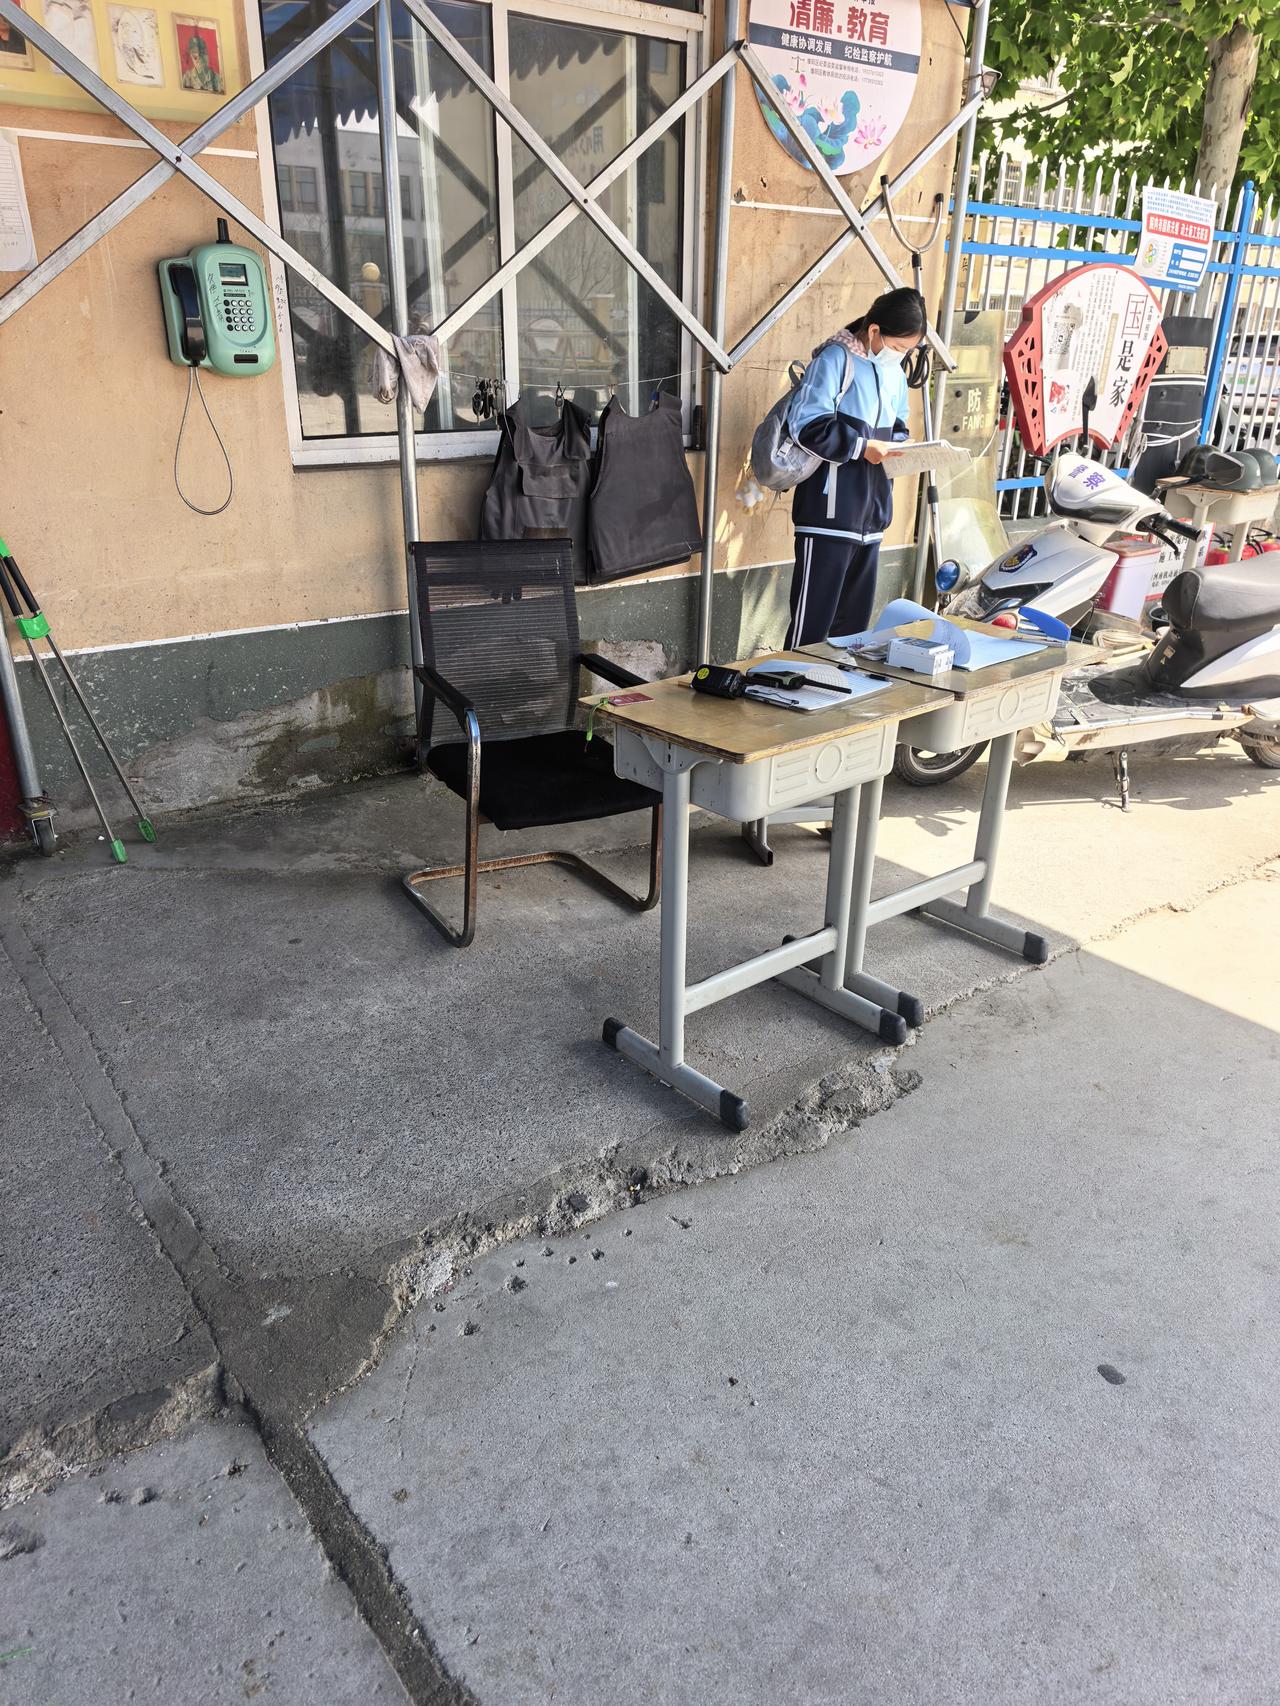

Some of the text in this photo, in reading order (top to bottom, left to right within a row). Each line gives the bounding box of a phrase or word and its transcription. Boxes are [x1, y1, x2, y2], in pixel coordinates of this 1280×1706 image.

[780, 32, 833, 56] 健康协调发展
[844, 45, 893, 67] 纪检监察护航
